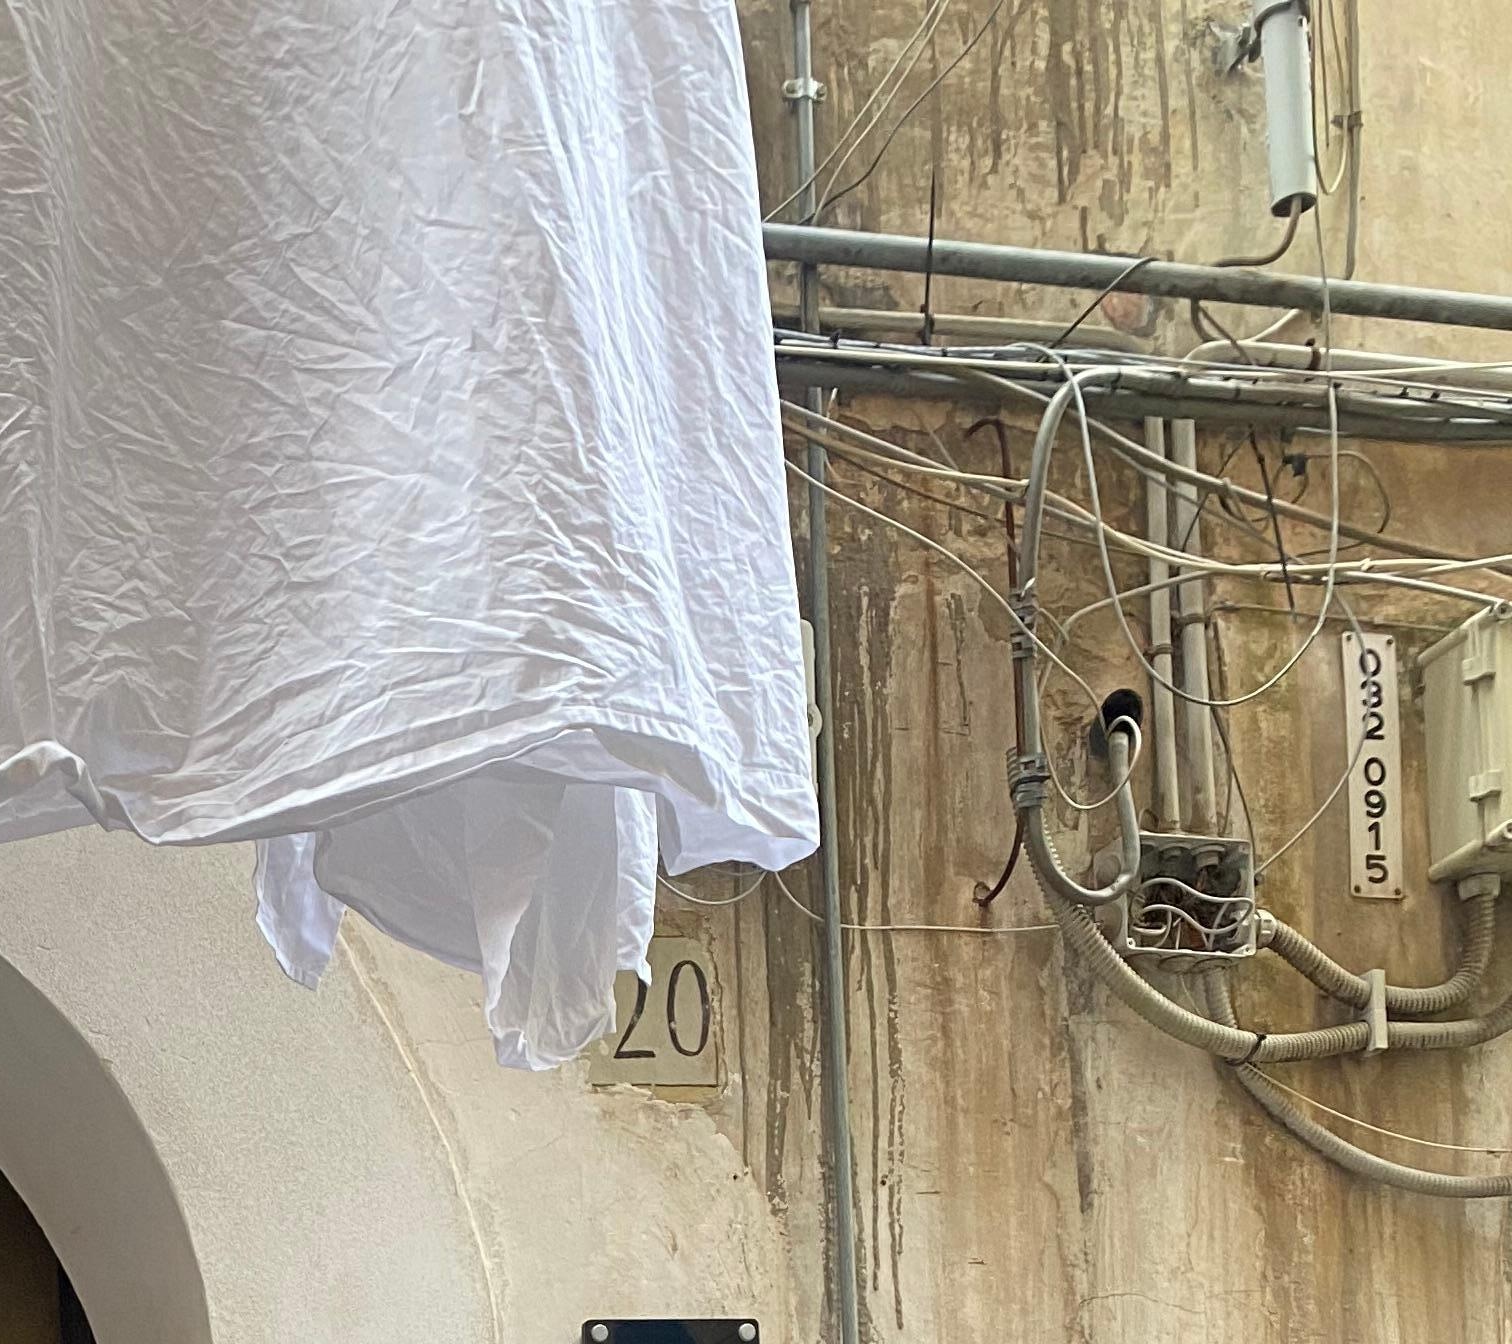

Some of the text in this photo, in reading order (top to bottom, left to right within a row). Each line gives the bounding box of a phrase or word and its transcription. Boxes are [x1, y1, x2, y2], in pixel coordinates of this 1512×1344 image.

[1358, 648, 1389, 885] 032 0915
[613, 960, 711, 1059] 20
